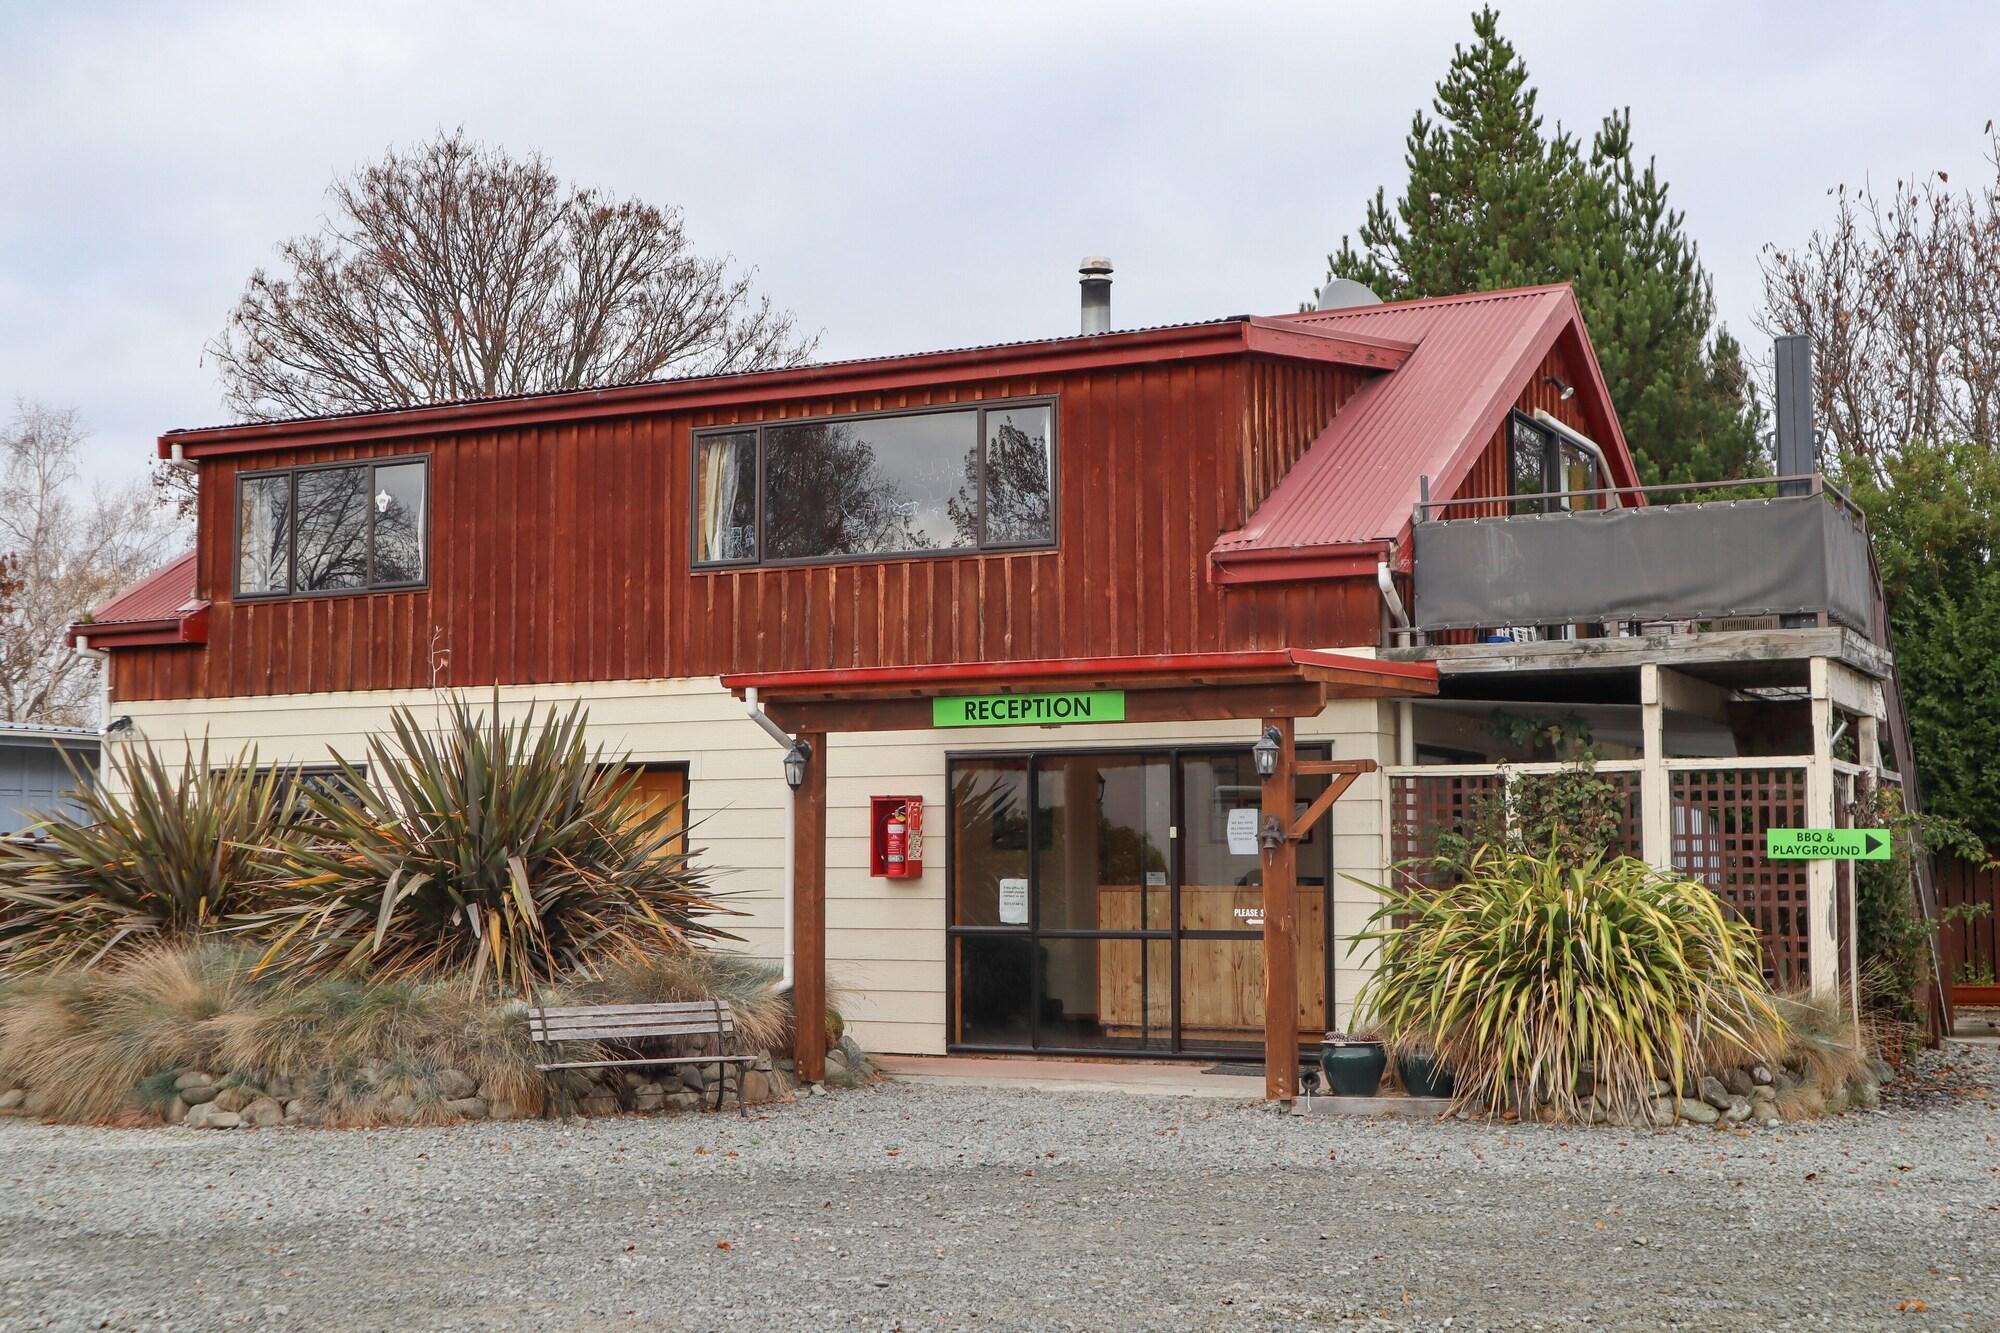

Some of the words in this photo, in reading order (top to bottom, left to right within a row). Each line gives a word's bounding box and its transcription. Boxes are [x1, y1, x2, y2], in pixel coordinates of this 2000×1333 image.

[964, 696, 1091, 720] RECEPTION
[1797, 832, 1822, 843] BBQ
[1826, 832, 1835, 842] &
[1773, 845, 1860, 856] PLAYGROUND
[1234, 908, 1259, 917] PLEASE
